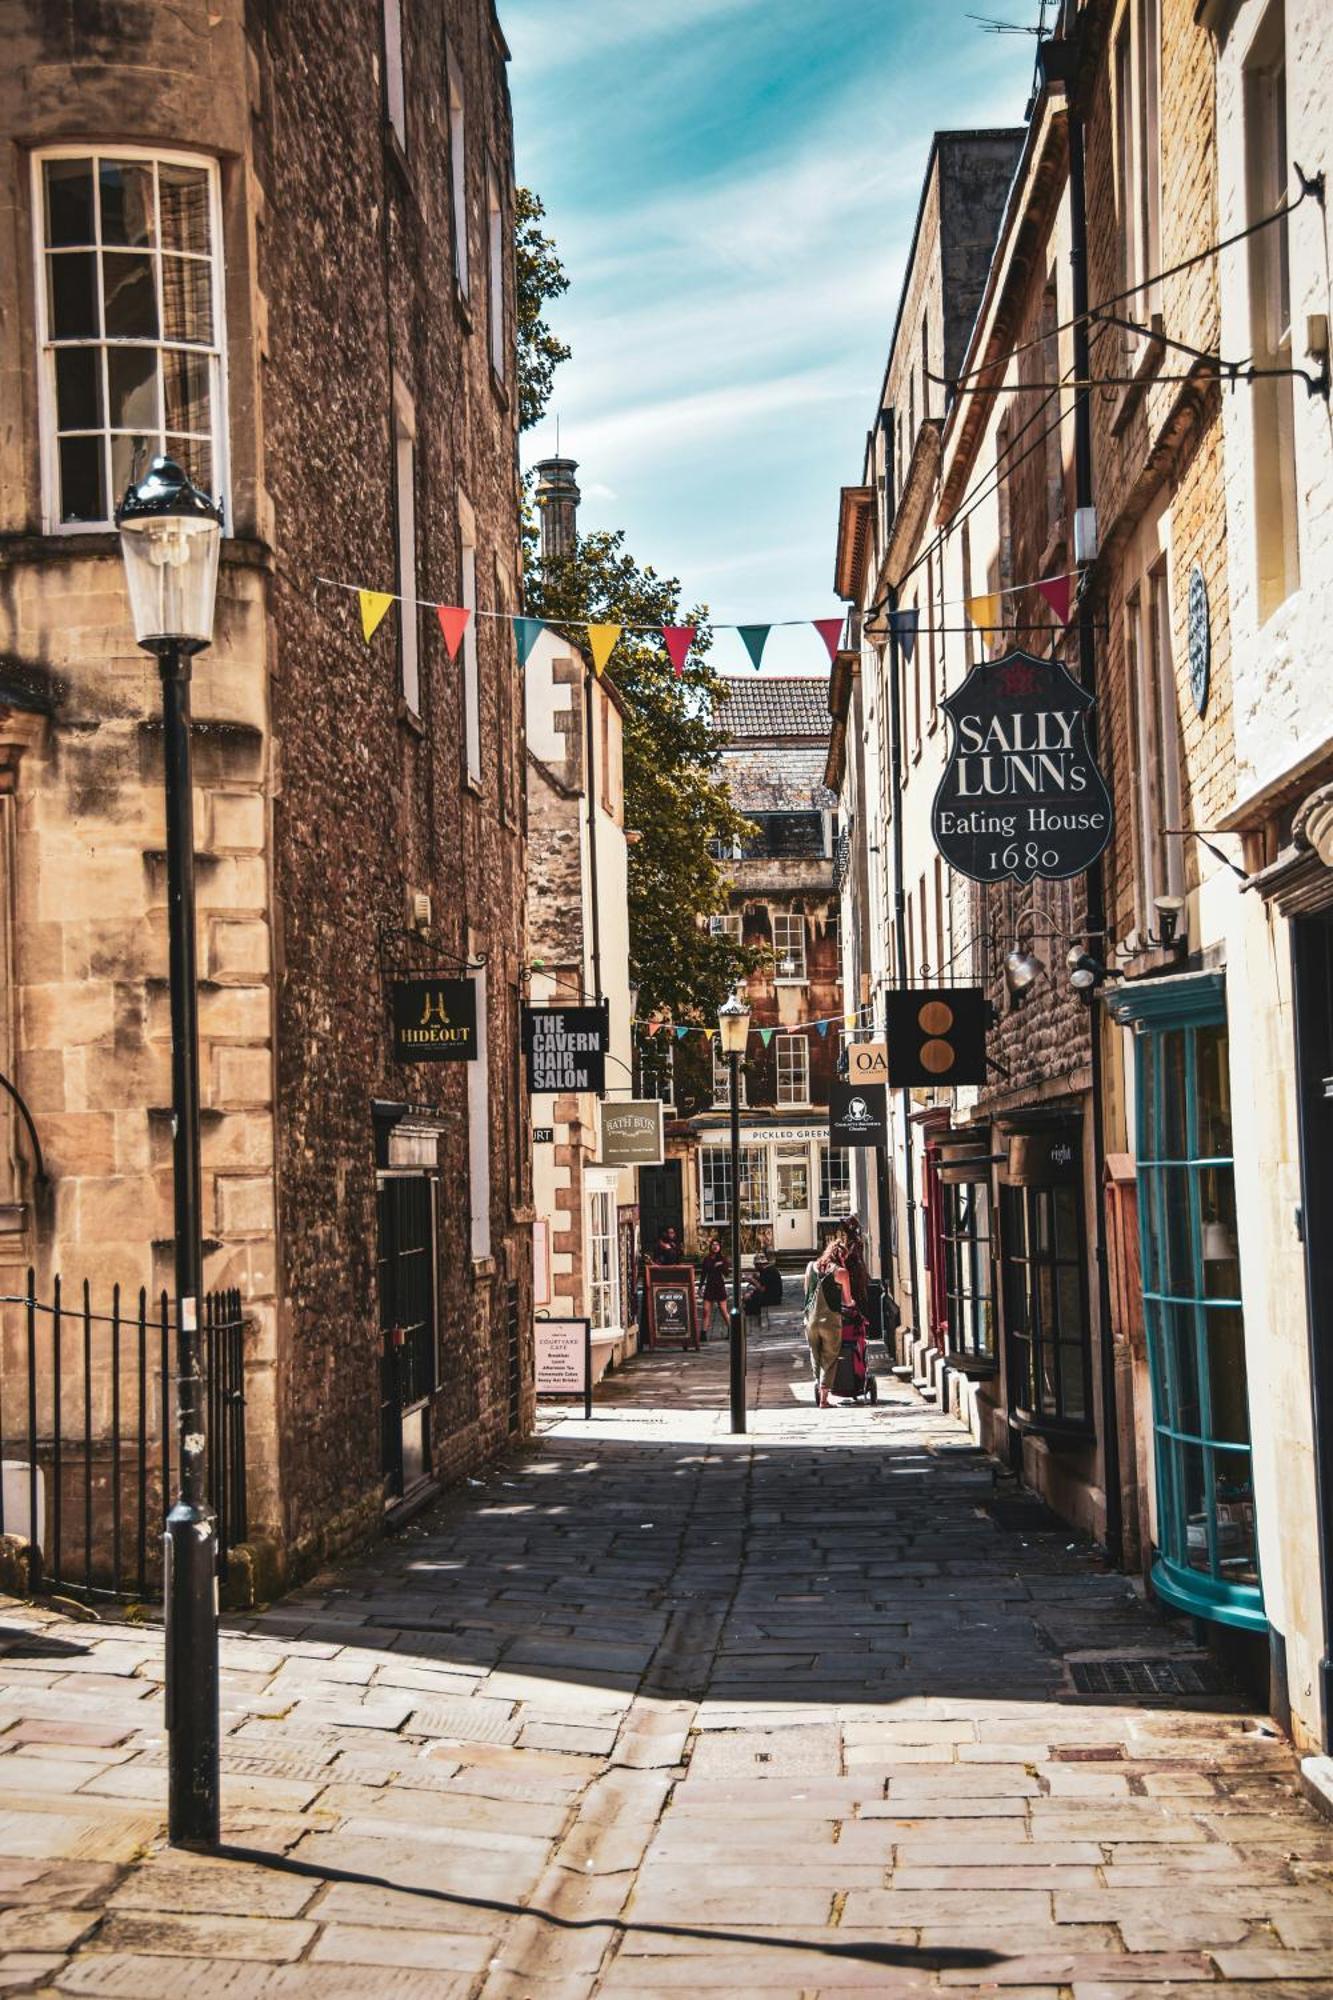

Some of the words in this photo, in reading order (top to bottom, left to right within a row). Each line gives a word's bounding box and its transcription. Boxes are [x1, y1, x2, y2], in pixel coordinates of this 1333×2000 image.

[960, 711, 1080, 753] SALLY
[956, 753, 1086, 796] LUNN's
[940, 811, 1017, 837] Eating
[1028, 808, 1105, 831] House
[989, 842, 1059, 870] 1680
[401, 1027, 470, 1042] HIDEOUT
[532, 1015, 565, 1034] THE
[532, 1032, 600, 1052] CAVERN
[533, 1051, 574, 1070] HAIR
[534, 1069, 588, 1089] SALON
[752, 1131, 793, 1139] PICKLED
